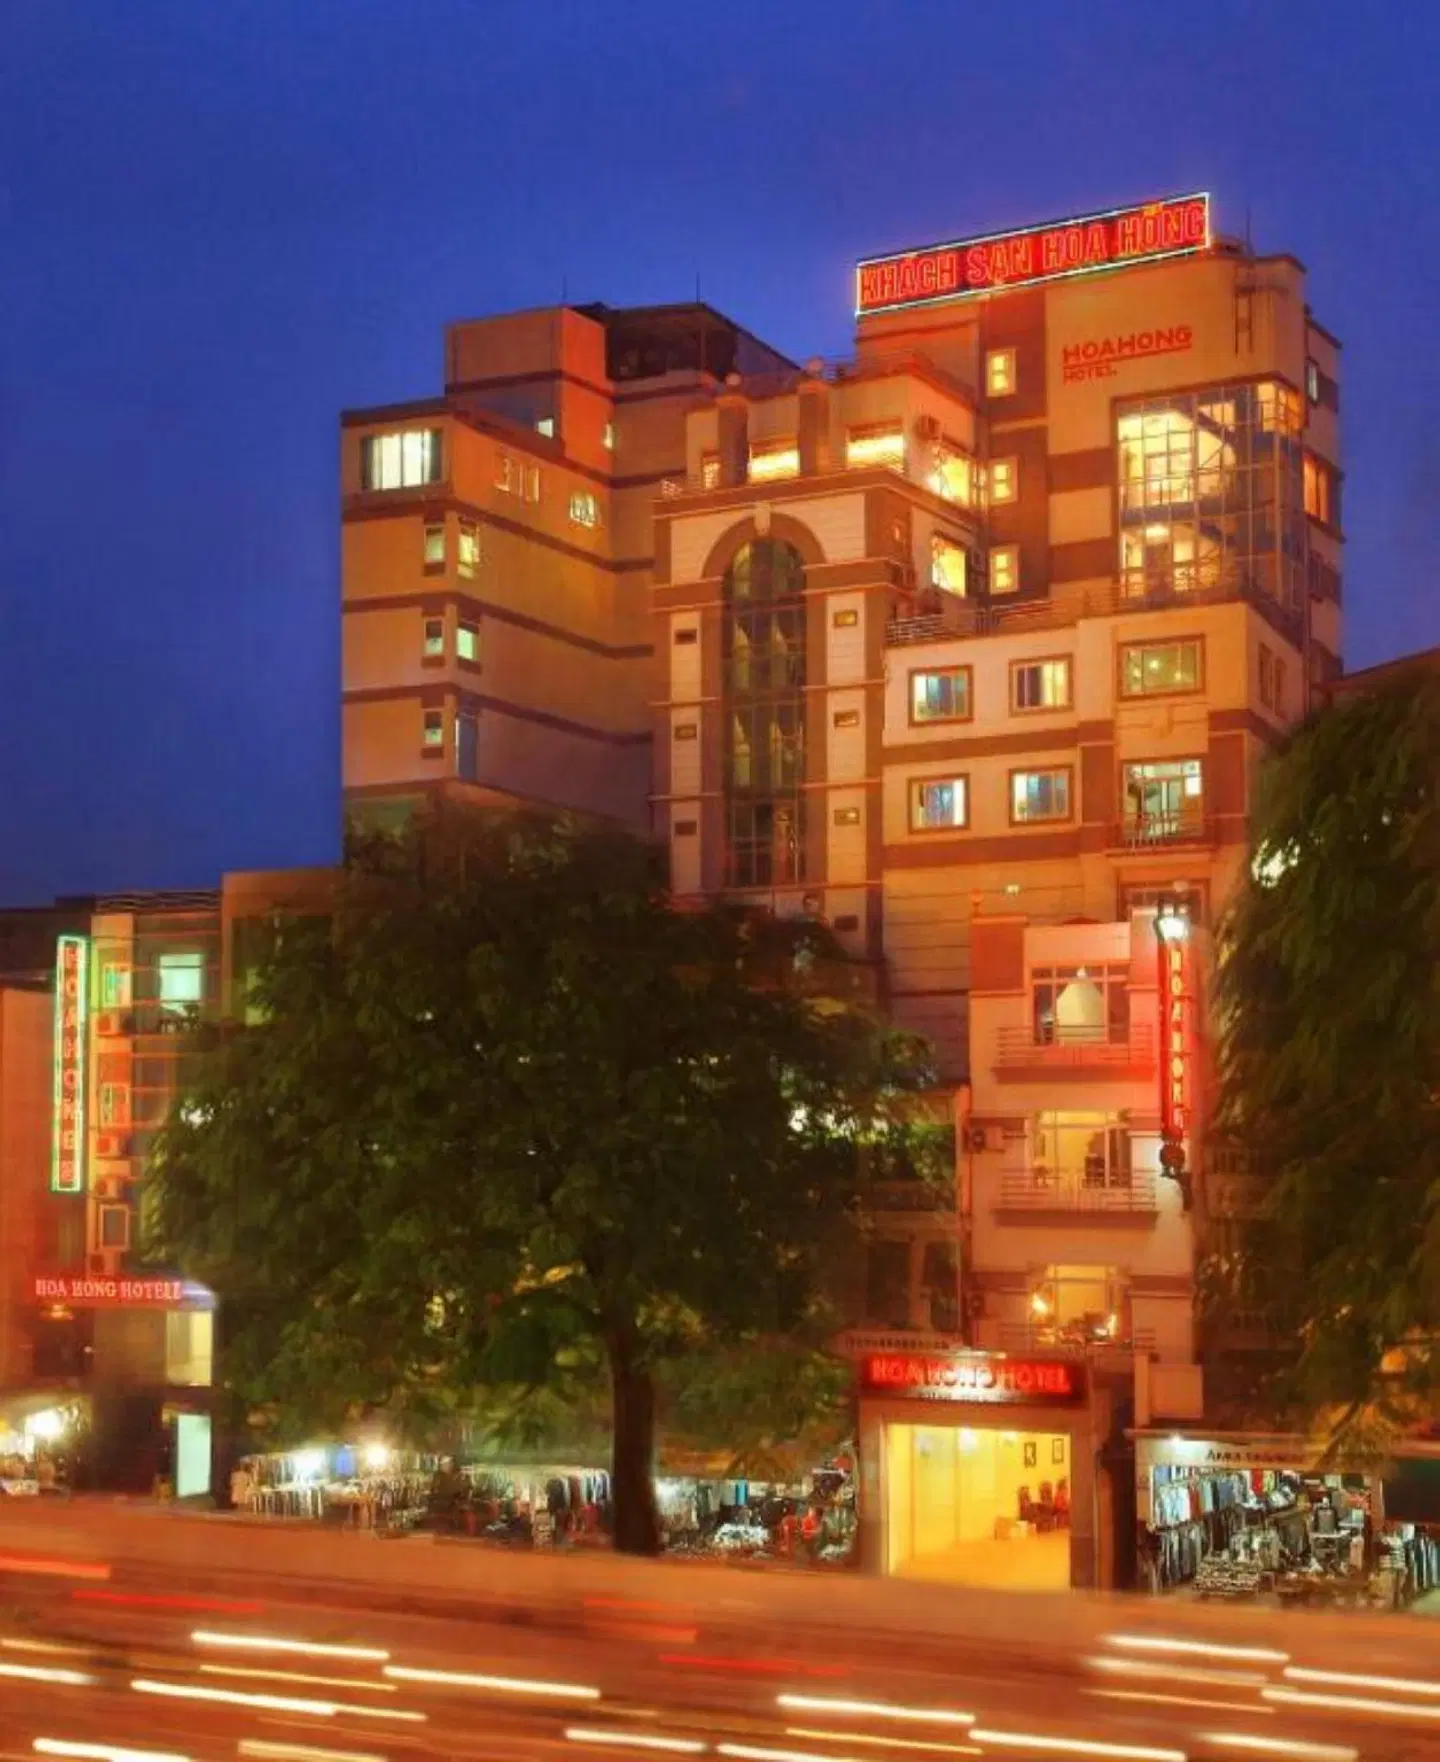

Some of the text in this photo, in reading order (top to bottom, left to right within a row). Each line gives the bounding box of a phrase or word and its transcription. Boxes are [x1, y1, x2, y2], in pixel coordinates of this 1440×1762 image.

[1043, 224, 1108, 269] HOA
[1062, 324, 1193, 364] HOAHONG
[35, 1279, 68, 1298] HOA
[72, 1281, 118, 1298] HONG
[871, 1359, 924, 1386] HOA
[996, 1362, 1073, 1395] HOTEL
